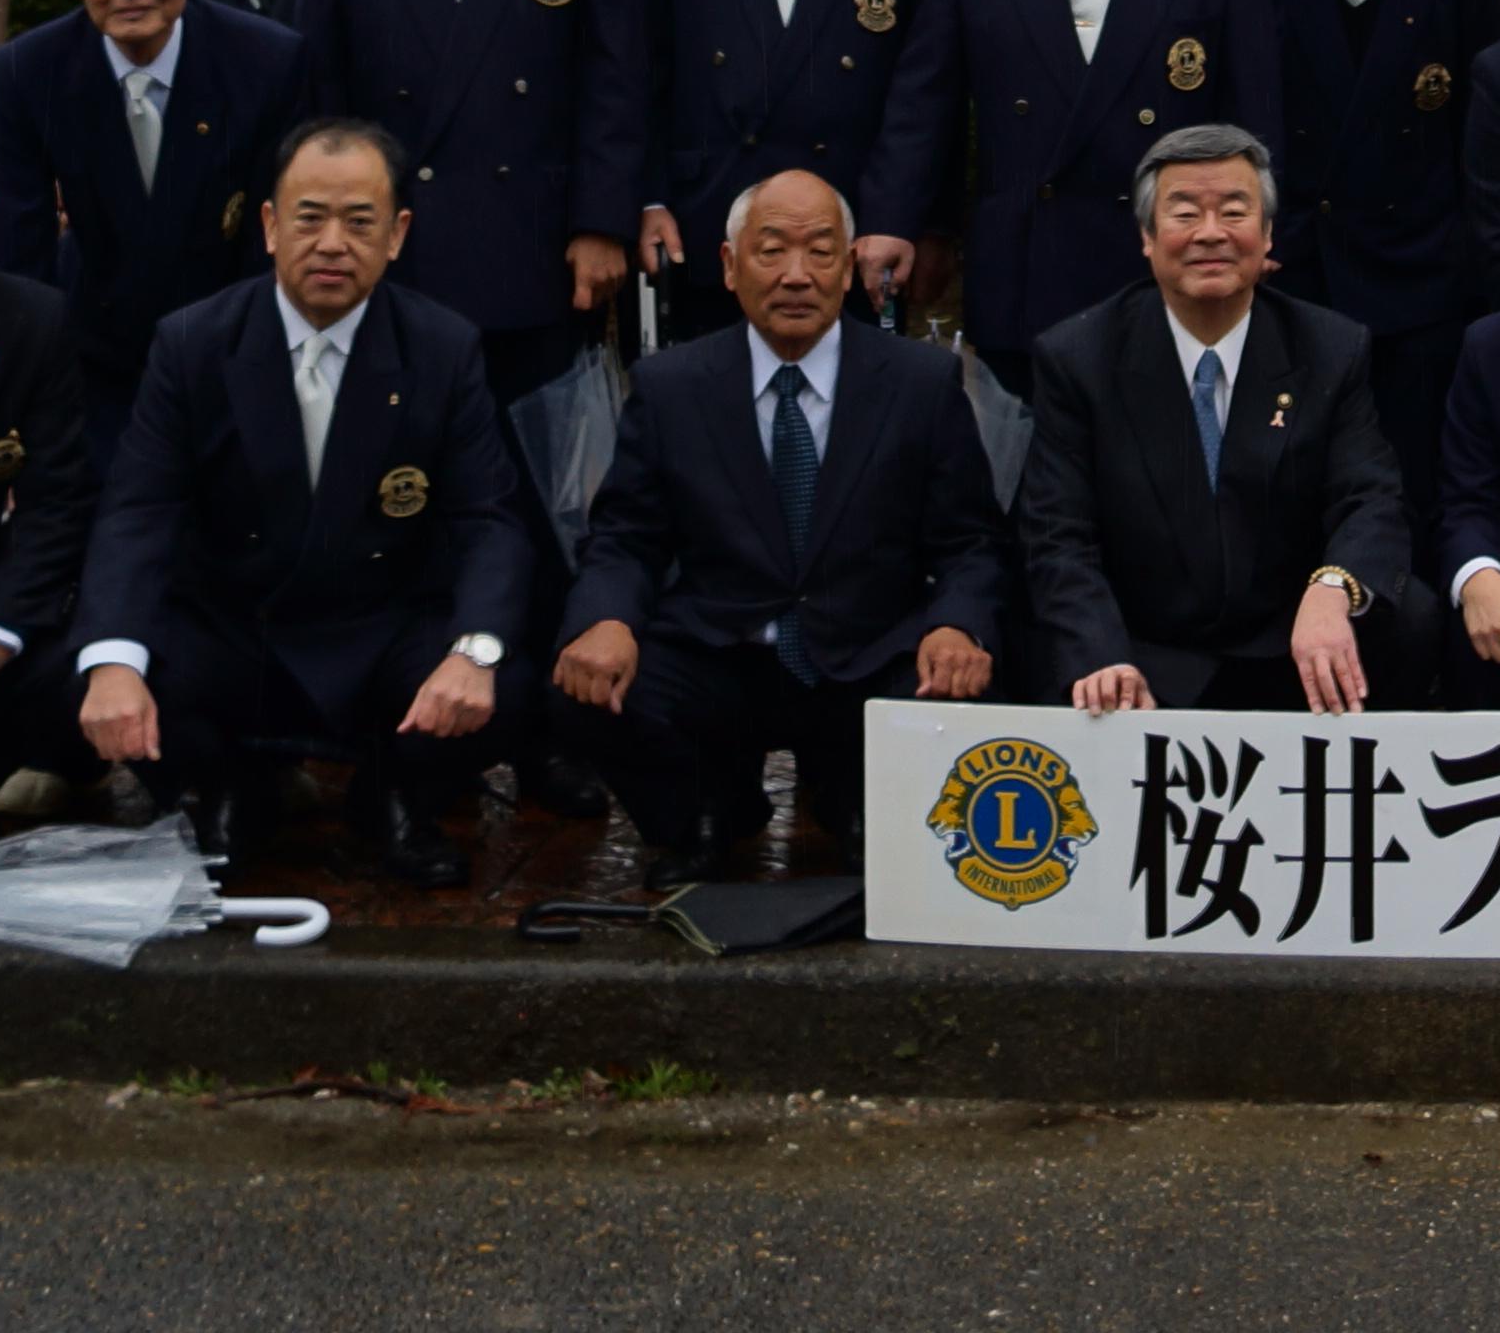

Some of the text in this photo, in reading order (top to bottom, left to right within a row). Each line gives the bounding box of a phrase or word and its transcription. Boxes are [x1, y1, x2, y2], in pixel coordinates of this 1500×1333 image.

[963, 743, 1062, 782] LIONS
[994, 791, 1038, 850] L
[964, 863, 1061, 896] INTERNATIONAL
